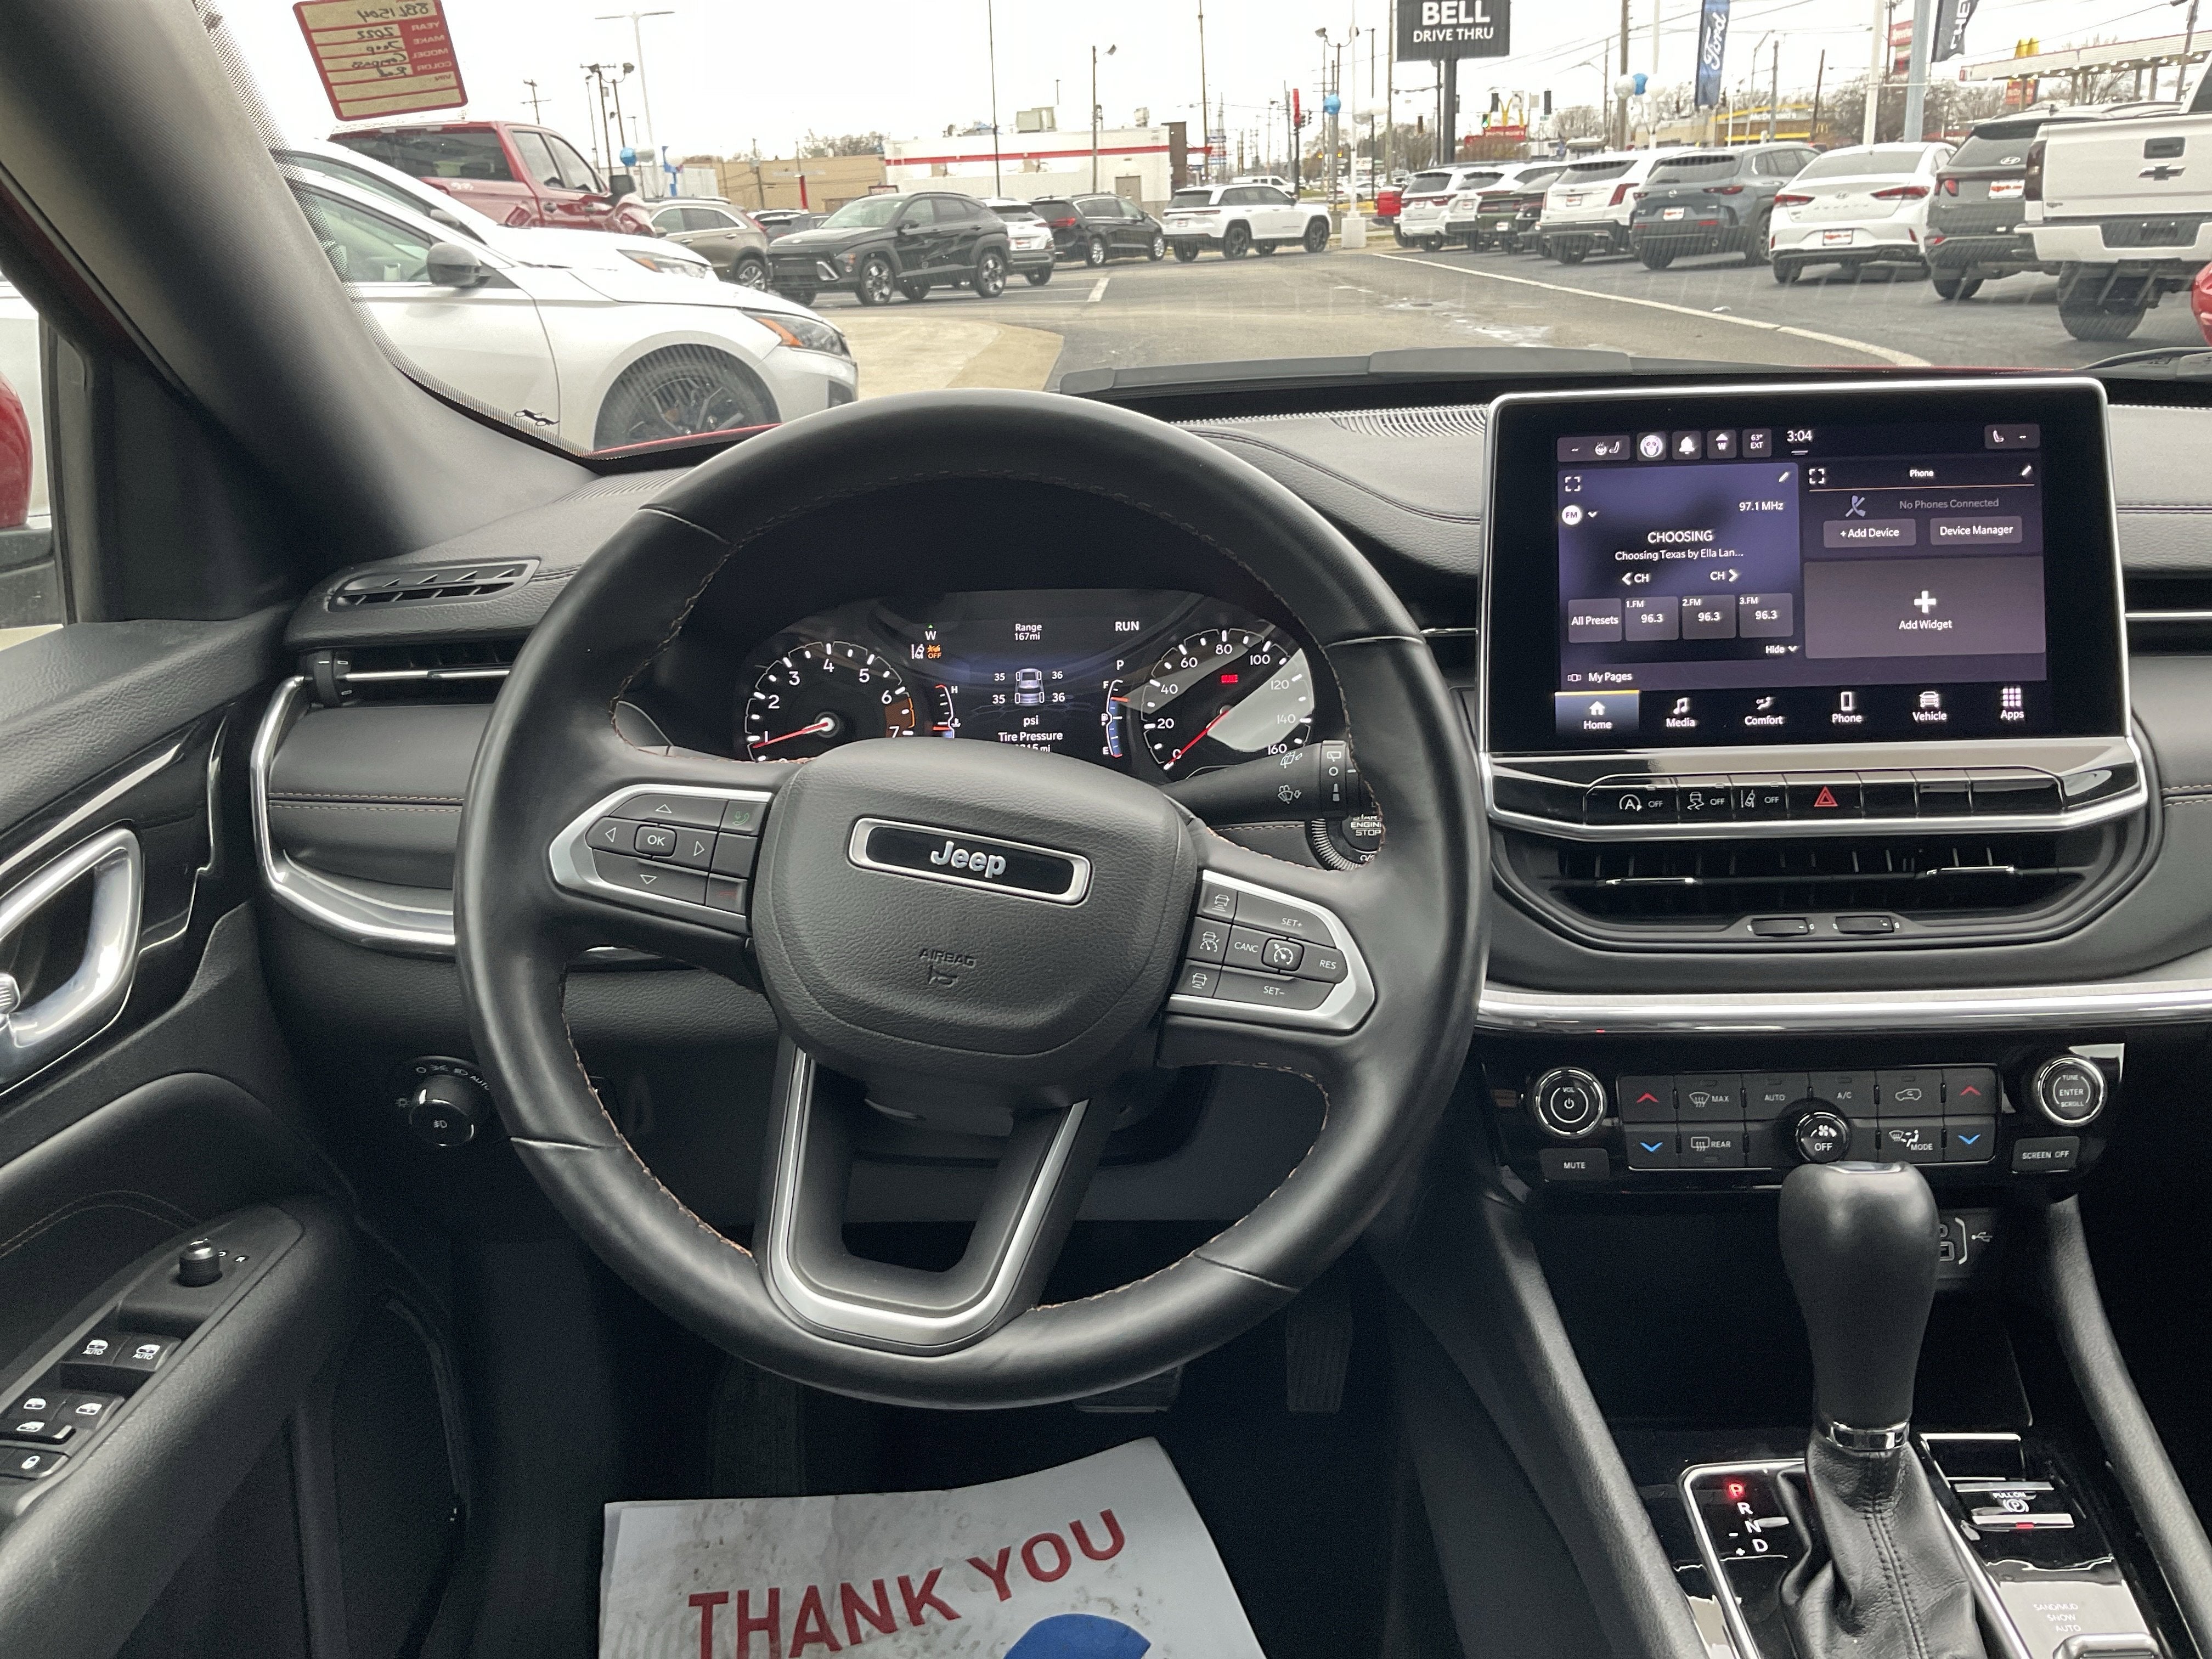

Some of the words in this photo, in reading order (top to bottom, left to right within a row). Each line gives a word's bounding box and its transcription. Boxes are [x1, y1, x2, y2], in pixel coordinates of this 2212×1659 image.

[1422, 1, 1491, 25] BELL
[1413, 29, 1453, 42] DRIVE
[1456, 27, 1493, 40] THRU
[1703, 12, 1726, 70] Ford
[1787, 430, 1812, 442] 3:04
[1718, 442, 1726, 450] W
[1910, 469, 1934, 477] Phone
[1739, 501, 1759, 511] 97.1
[1761, 501, 1784, 511] MHz
[1899, 500, 1913, 509] No
[1915, 500, 1948, 509] Phones
[1950, 498, 1999, 508] Connected
[1869, 527, 1899, 538] Device
[1940, 526, 1971, 536] Device
[1973, 525, 2013, 536] Manager
[1647, 530, 1713, 543] CHOOSING
[1615, 551, 1658, 561] Choosing
[1660, 550, 1686, 560] Texas
[1688, 549, 1699, 560] by
[1701, 549, 1717, 557] Ella
[1634, 574, 1649, 583] CH
[1710, 571, 1725, 580] CH
[1626, 600, 1644, 608] 1.FM
[1682, 598, 1701, 606] 2.FM
[1739, 596, 1758, 605] 3.FM
[1571, 616, 1583, 625] All
[1585, 615, 1618, 625] Presets
[1641, 613, 1663, 623] 96.3
[1698, 612, 1720, 622] 96.3
[1755, 610, 1777, 620] 96.3
[1015, 623, 1042, 632] Range
[1115, 621, 1139, 631] RUN
[1899, 620, 1917, 629] Add
[1919, 619, 1953, 630] Widget
[925, 631, 936, 640] W
[1014, 633, 1041, 641] 167mi
[1215, 644, 1233, 655] 80
[1765, 645, 1785, 654] Hide
[1180, 657, 1198, 668] 60
[1250, 654, 1270, 665] 100
[823, 658, 834, 673] 4
[1116, 660, 1124, 670] P
[788, 671, 801, 686] 3
[859, 668, 870, 682] 5
[994, 673, 1005, 681] 35
[1052, 671, 1063, 680] 36
[1588, 673, 1603, 684] My
[1605, 672, 1632, 683] Pages
[1103, 680, 1109, 689] F
[1160, 684, 1178, 695] 40
[1271, 679, 1289, 690] 120
[951, 686, 958, 694] H
[769, 695, 780, 709] 2
[881, 690, 892, 704] 6
[992, 695, 1006, 704] 35
[1052, 693, 1065, 702] 36
[1277, 713, 1295, 724] 140
[1745, 715, 1783, 725] Comfort
[1832, 714, 1862, 723] Phone
[1912, 711, 1947, 720] Vehicle
[2001, 710, 2024, 720] Apps
[1023, 714, 1039, 727] psi
[1157, 718, 1175, 729] 20
[1583, 720, 1612, 730] Home
[1666, 718, 1695, 727] Media
[889, 726, 900, 738] 7
[998, 732, 1018, 742] Tire
[1020, 731, 1064, 741] Pressure
[1103, 747, 1109, 755] E
[1267, 743, 1287, 754] 160
[1648, 800, 1663, 808] OFF
[1710, 798, 1725, 806] OFF
[1764, 796, 1779, 804] OFF
[647, 835, 666, 847] OK
[930, 840, 1006, 878] Jeep
[1234, 941, 1259, 953] CANC
[919, 948, 977, 968] AIRBAG
[1319, 960, 1336, 969] RES
[1837, 1091, 1852, 1099] A/C
[2059, 1088, 2084, 1096] ENTER
[1814, 1142, 1832, 1152] OFF
[2022, 1152, 2051, 1160] SCREEN
[2055, 1150, 2070, 1158] OFF
[1729, 1483, 1744, 1497] P
[1737, 1502, 1753, 1515] R
[1745, 1520, 1762, 1533] N
[1752, 1539, 1768, 1552] D
[689, 1567, 961, 1659] THANK
[966, 1509, 1126, 1602] YOU
